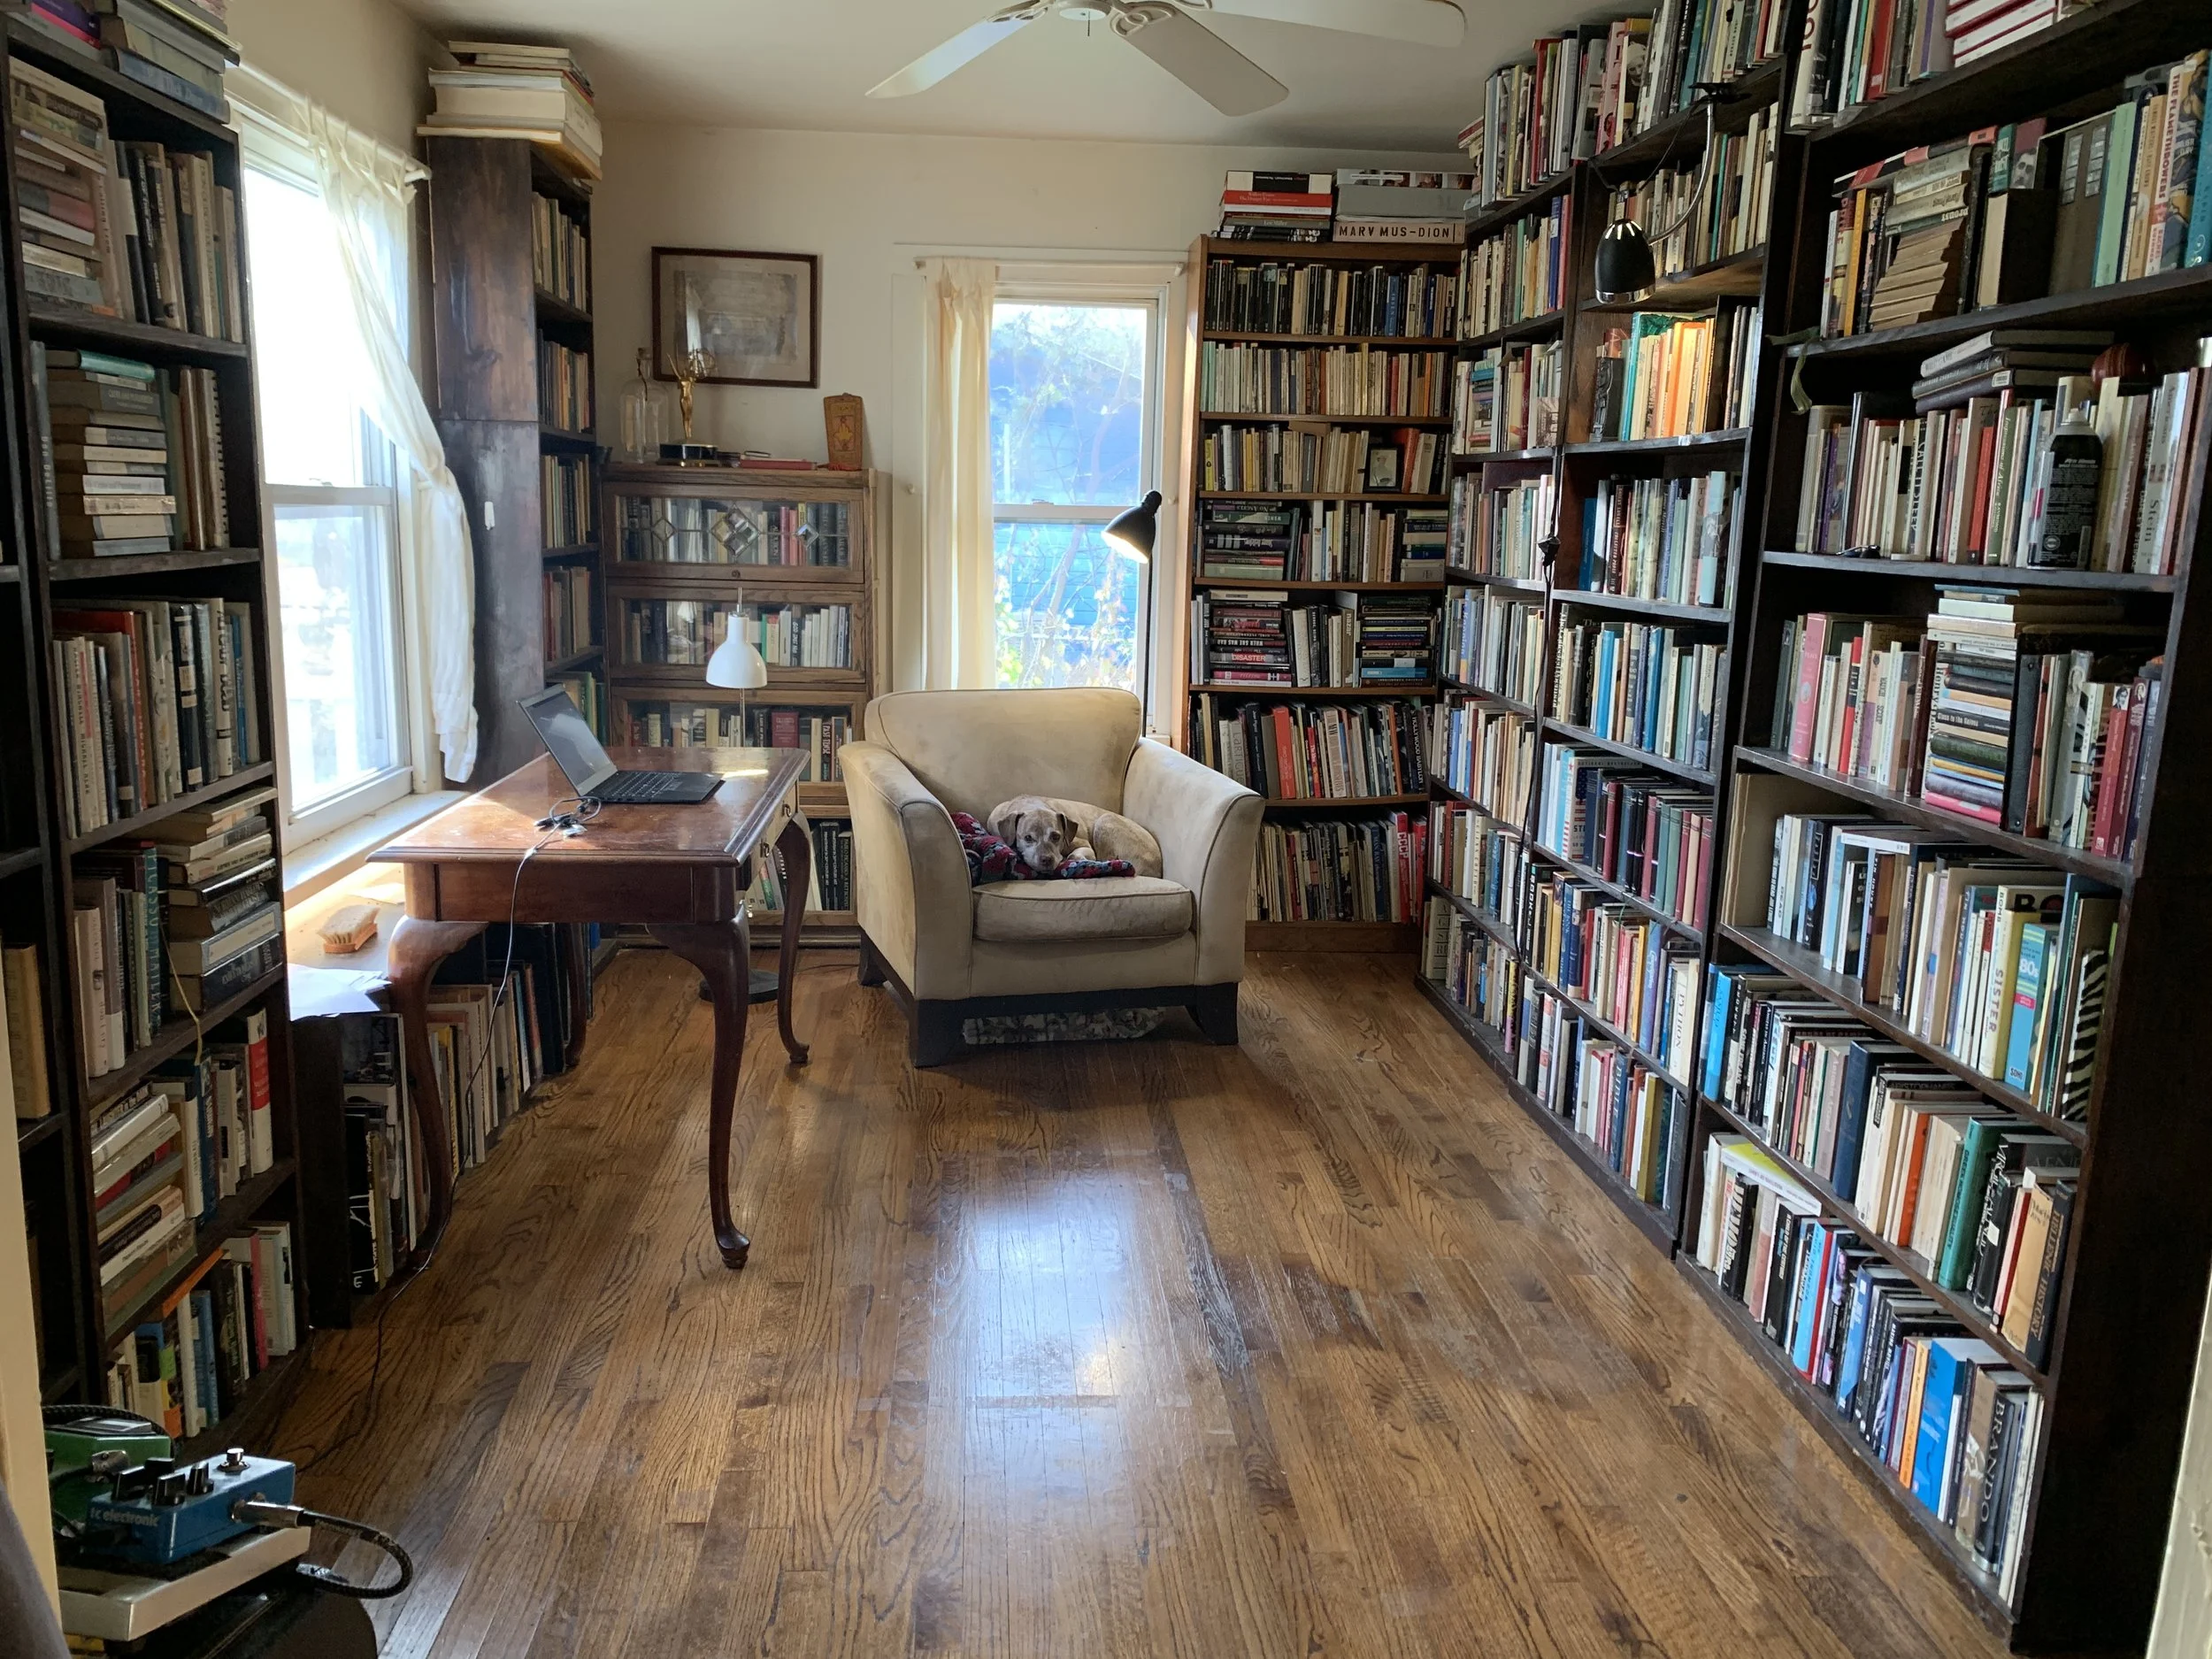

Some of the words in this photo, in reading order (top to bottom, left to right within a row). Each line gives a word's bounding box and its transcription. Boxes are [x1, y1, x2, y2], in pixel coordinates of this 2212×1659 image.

[2170, 73, 2180, 96] THE
[2158, 98, 2177, 198] FLAMETHROWERS
[1379, 227, 1449, 238] MUS-DION
[41, 435, 50, 457] Don
[43, 464, 53, 507] DeLillo
[2144, 499, 2161, 542] Stein
[1411, 717, 1421, 754] HOLLYWOOD
[1415, 756, 1424, 783] BABYLON
[1396, 831, 1409, 858] CCCP
[146, 854, 158, 926] PICASSO
[1996, 891, 2005, 923] BOMB
[1955, 916, 1966, 956] HOUSE
[149, 948, 161, 1011] MAILER
[2019, 960, 2039, 979] 80s
[1675, 994, 1685, 1048] PYTHON
[1988, 968, 2004, 1033] SISTER
[1612, 1065, 1622, 1118] BIBLE
[1959, 1149, 1970, 1178] GREEK
[1991, 1143, 2008, 1185] VIRGIL
[2040, 1210, 2061, 1277] HELLENIC
[2029, 1277, 2048, 1338] HISTORY
[1979, 1399, 2007, 1523] BRANDO
[103, 1509, 159, 1528] electronic
